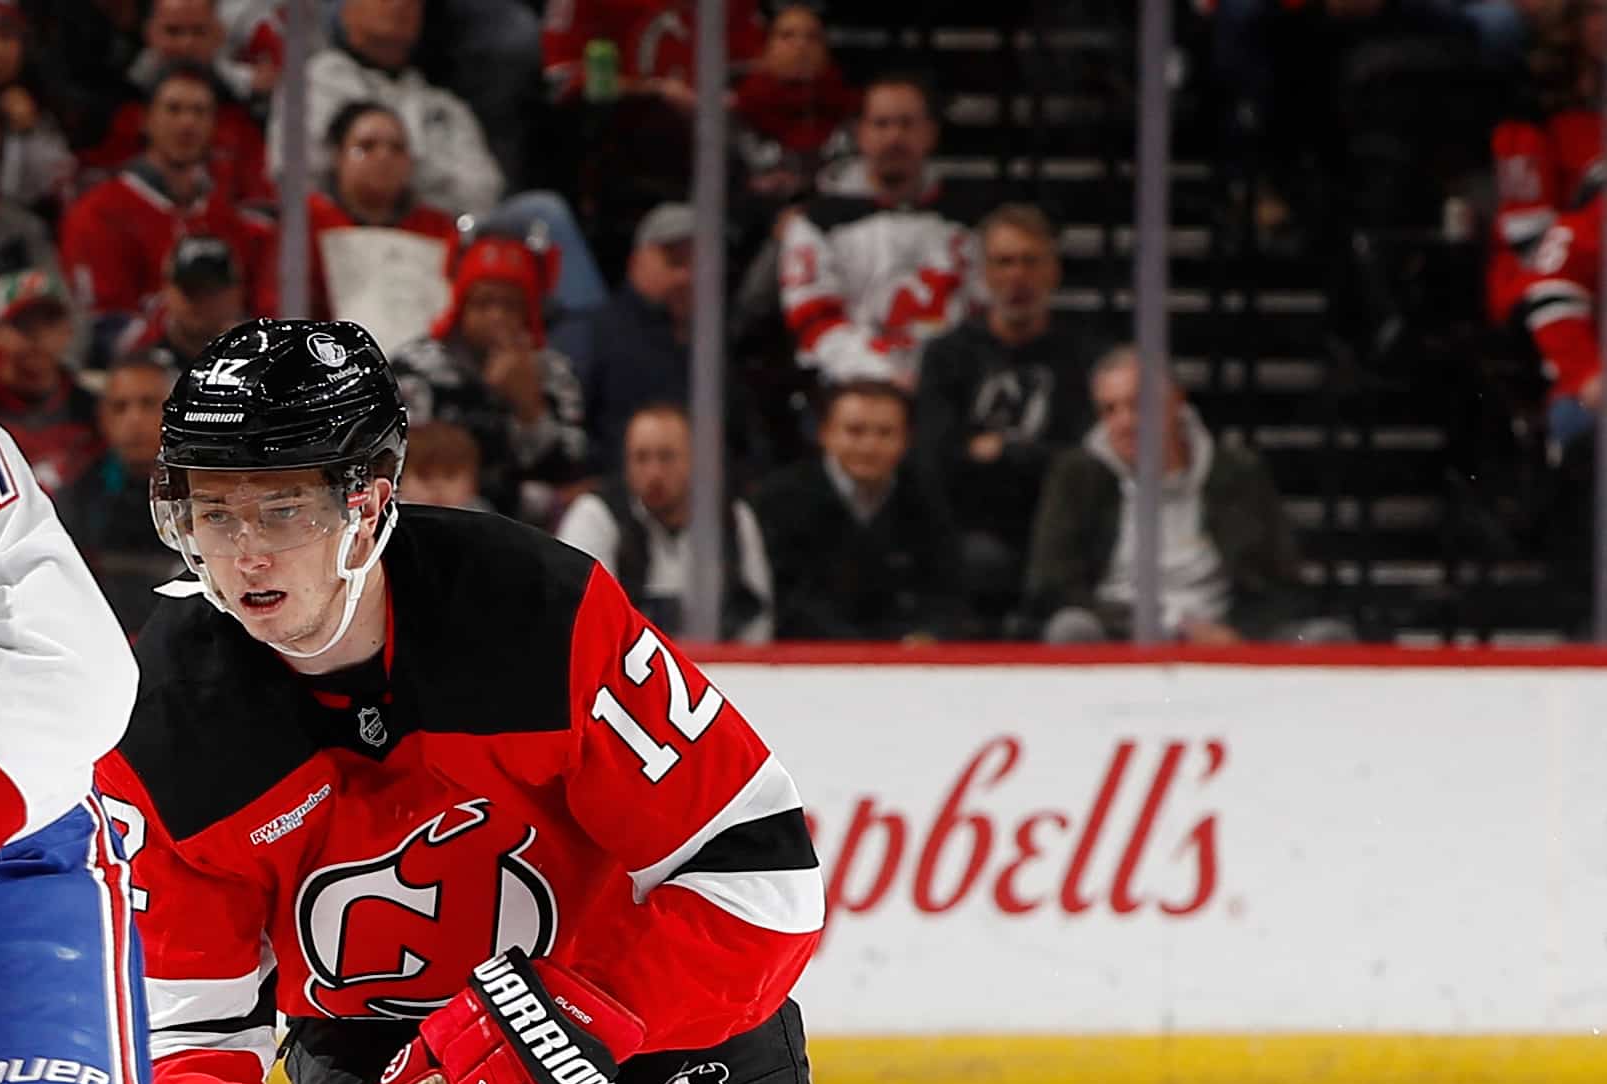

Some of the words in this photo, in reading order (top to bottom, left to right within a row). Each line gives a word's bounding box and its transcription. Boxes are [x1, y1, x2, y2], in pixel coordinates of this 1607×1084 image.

[184, 411, 245, 423] WARRIOR
[590, 626, 725, 785] 12
[805, 733, 1227, 952] pbell's
